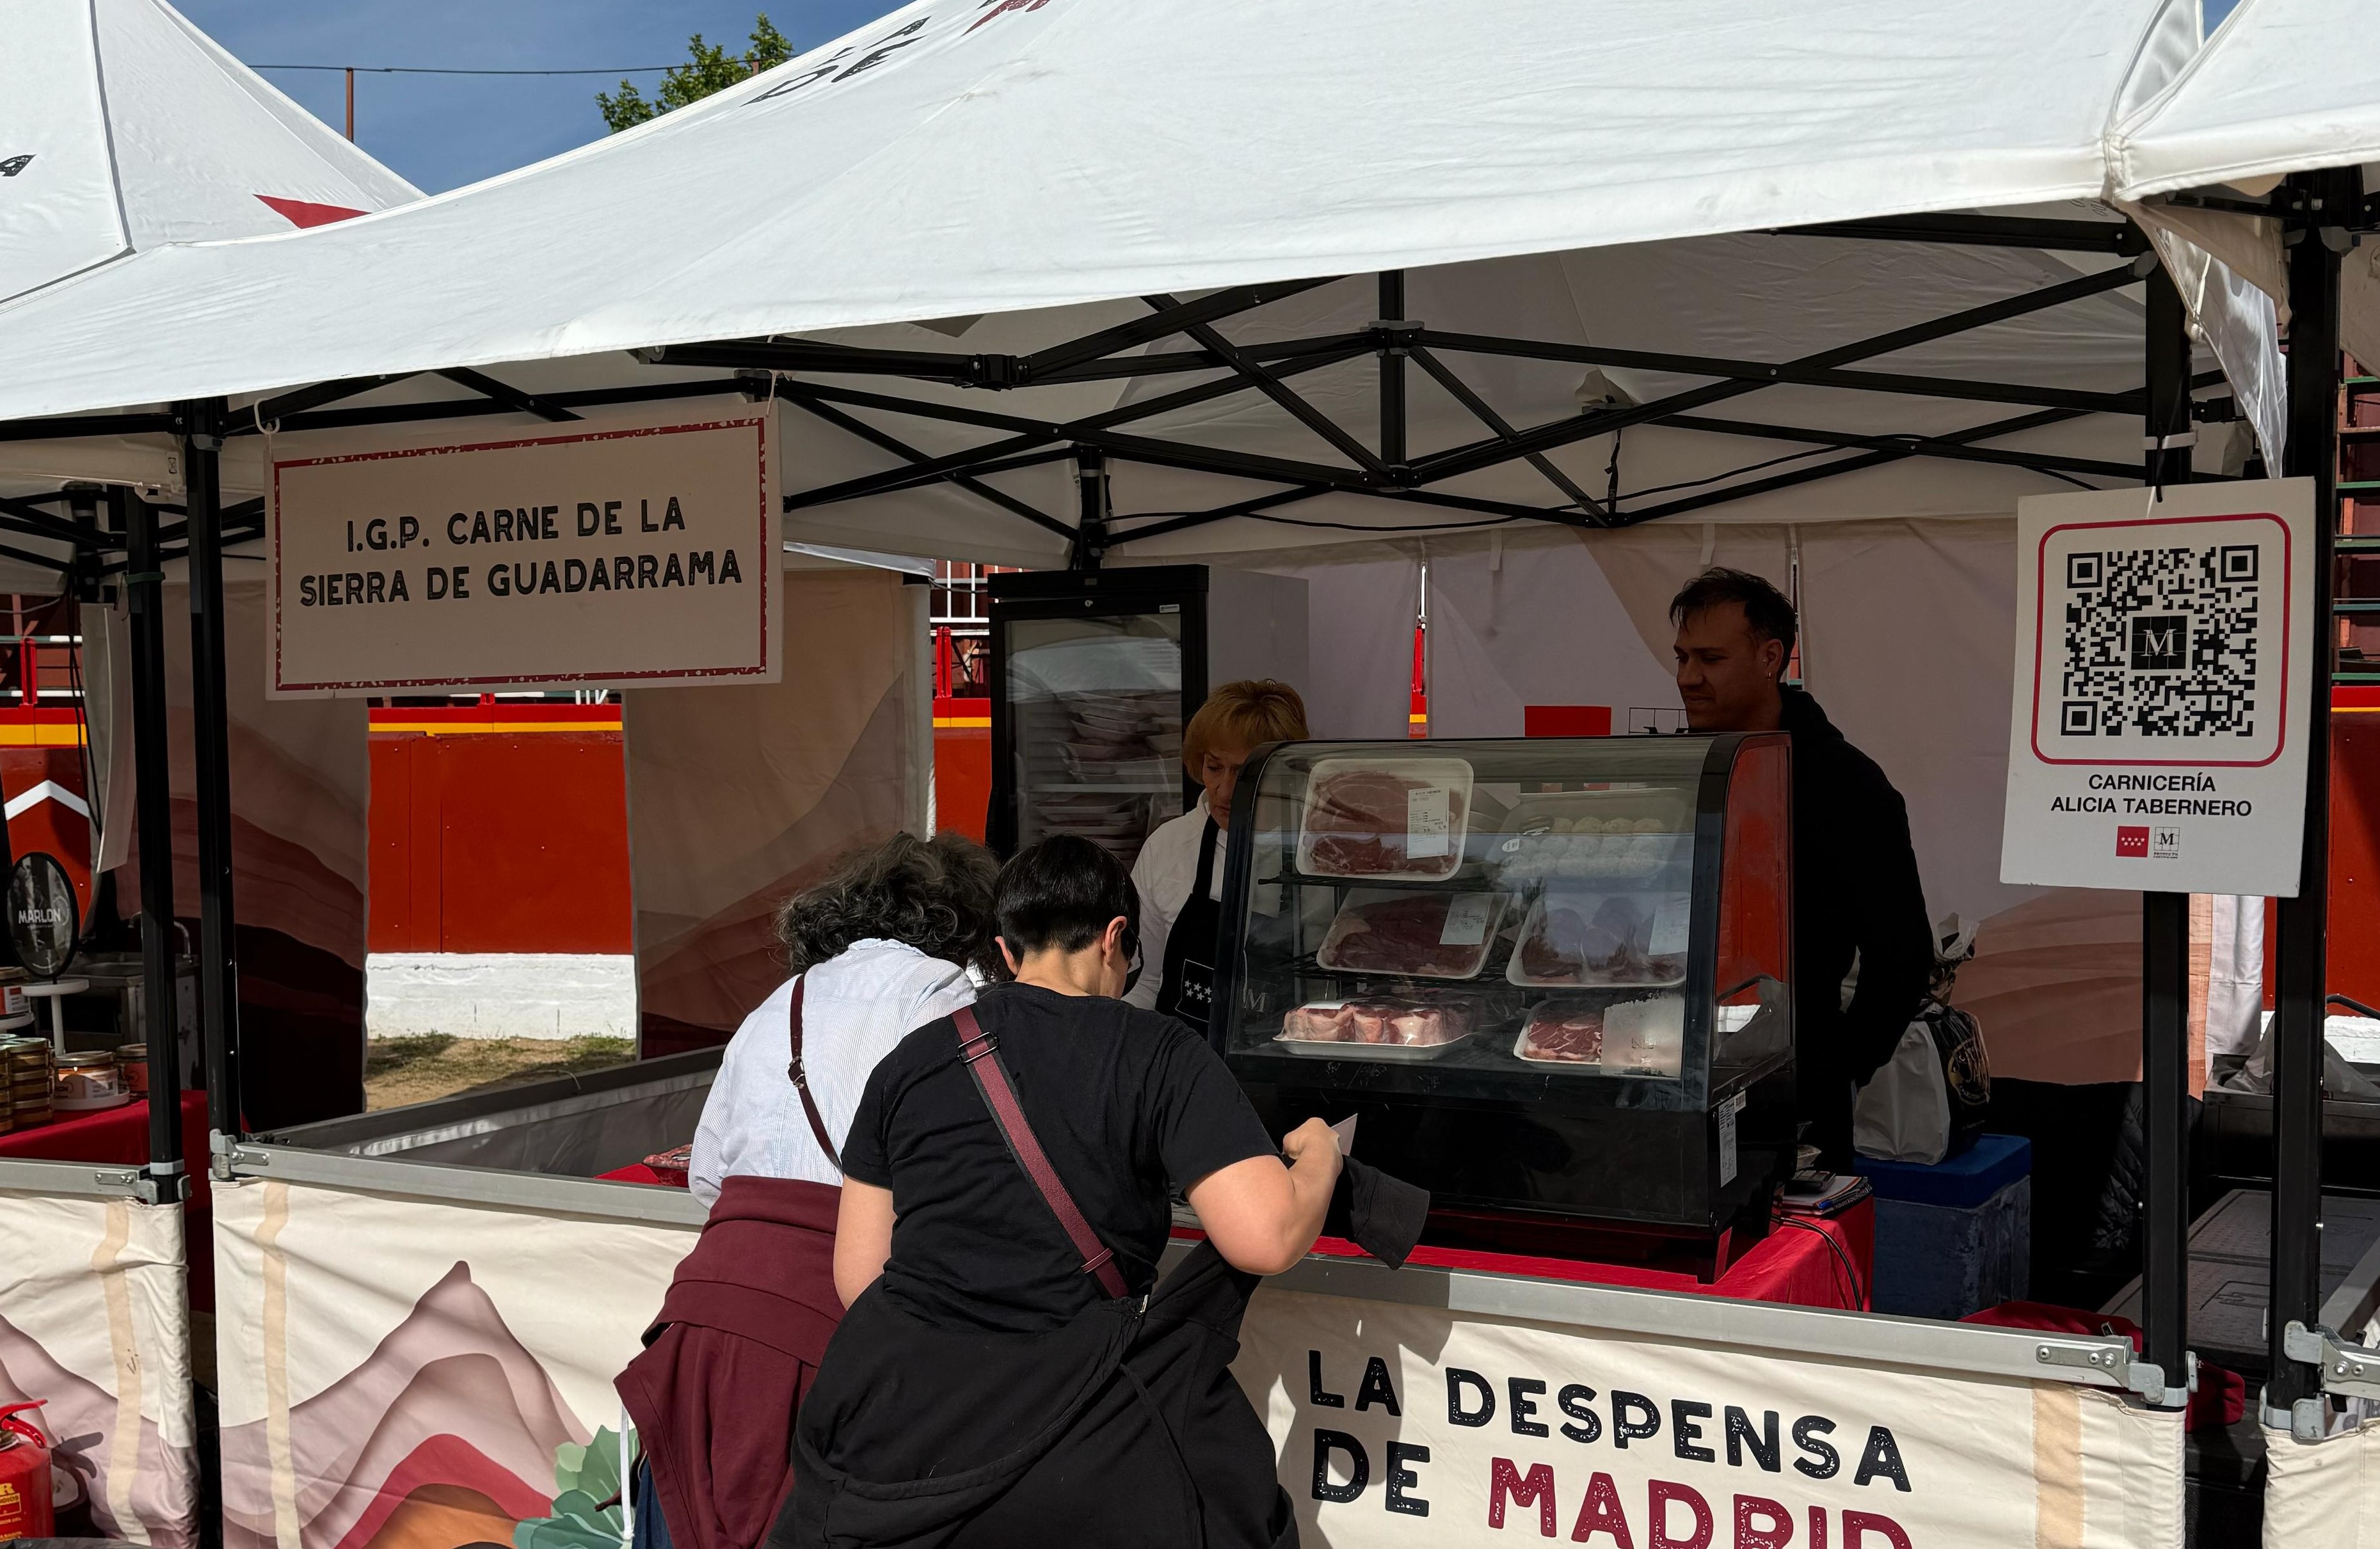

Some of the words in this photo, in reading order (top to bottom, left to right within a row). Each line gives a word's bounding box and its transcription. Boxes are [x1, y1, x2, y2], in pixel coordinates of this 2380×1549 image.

[347, 516, 430, 552] I.G.P.
[447, 505, 559, 545] CARNE
[577, 501, 622, 537] DE
[641, 496, 685, 532] LA
[300, 569, 410, 607] SIERRA
[427, 566, 470, 601] DE
[487, 549, 742, 597] GUADARRAMA
[2140, 628, 2178, 656] M
[2088, 772, 2216, 791] CARNICERÍA
[2050, 797, 2117, 813] ALICIA
[2123, 798, 2252, 816] TABERNERO
[2159, 832, 2175, 845] M
[19, 908, 61, 924] MARLON
[1309, 1350, 1402, 1417] LA
[1446, 1367, 1912, 1493] DESPENSA
[1311, 1428, 1430, 1517] DE
[1489, 1457, 1913, 1549] MADRID
